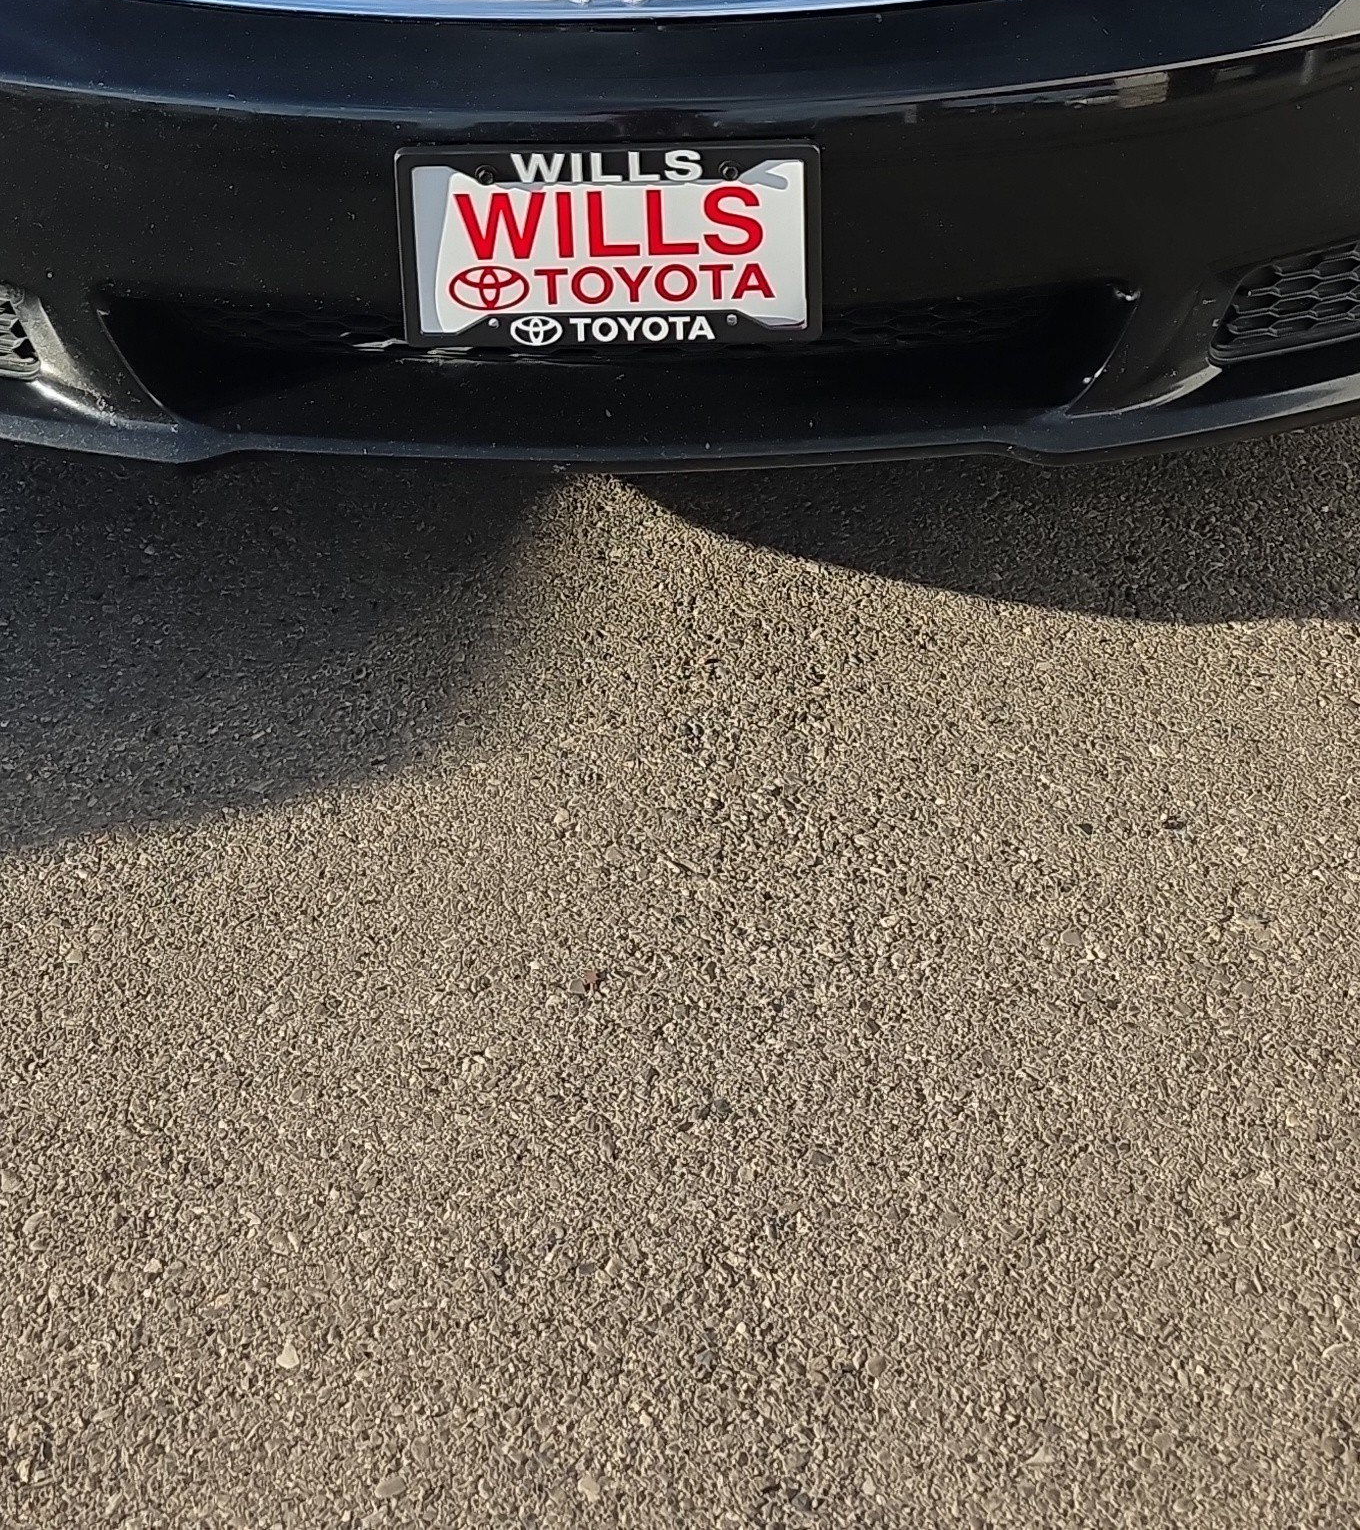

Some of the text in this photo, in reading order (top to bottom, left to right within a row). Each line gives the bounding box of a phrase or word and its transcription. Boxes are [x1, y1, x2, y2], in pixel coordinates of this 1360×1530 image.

[510, 150, 704, 183] WILLS
[454, 186, 764, 261] WILLS
[533, 263, 775, 305] TOYOTA
[569, 315, 716, 342] TOYOTA
